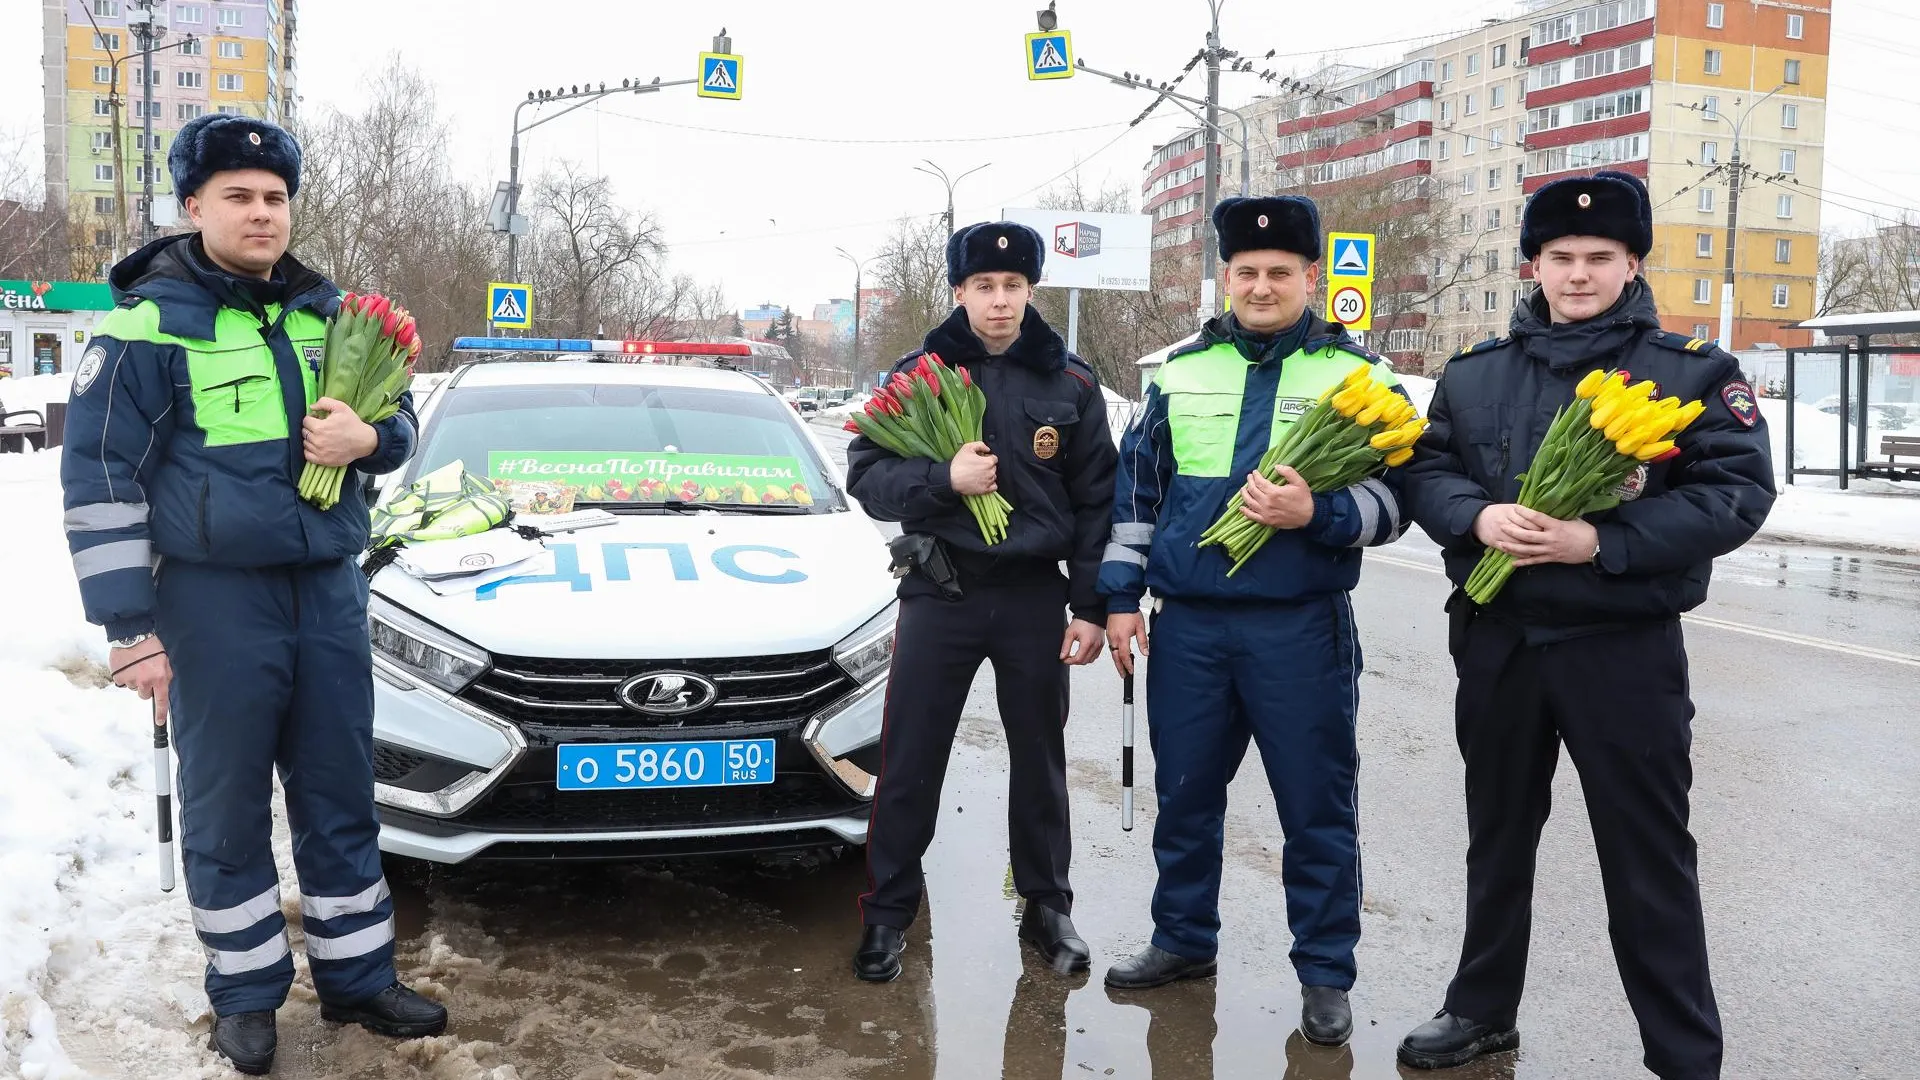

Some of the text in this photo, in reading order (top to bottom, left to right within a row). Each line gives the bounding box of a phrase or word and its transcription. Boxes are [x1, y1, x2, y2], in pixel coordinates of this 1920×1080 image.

[1340, 298, 1358, 313] 20
[497, 458, 796, 482] #ВеснаПоПравилам
[475, 543, 808, 601] ДПС
[615, 747, 705, 782] 5860
[728, 743, 762, 769] 50
[732, 770, 757, 780] RUS
